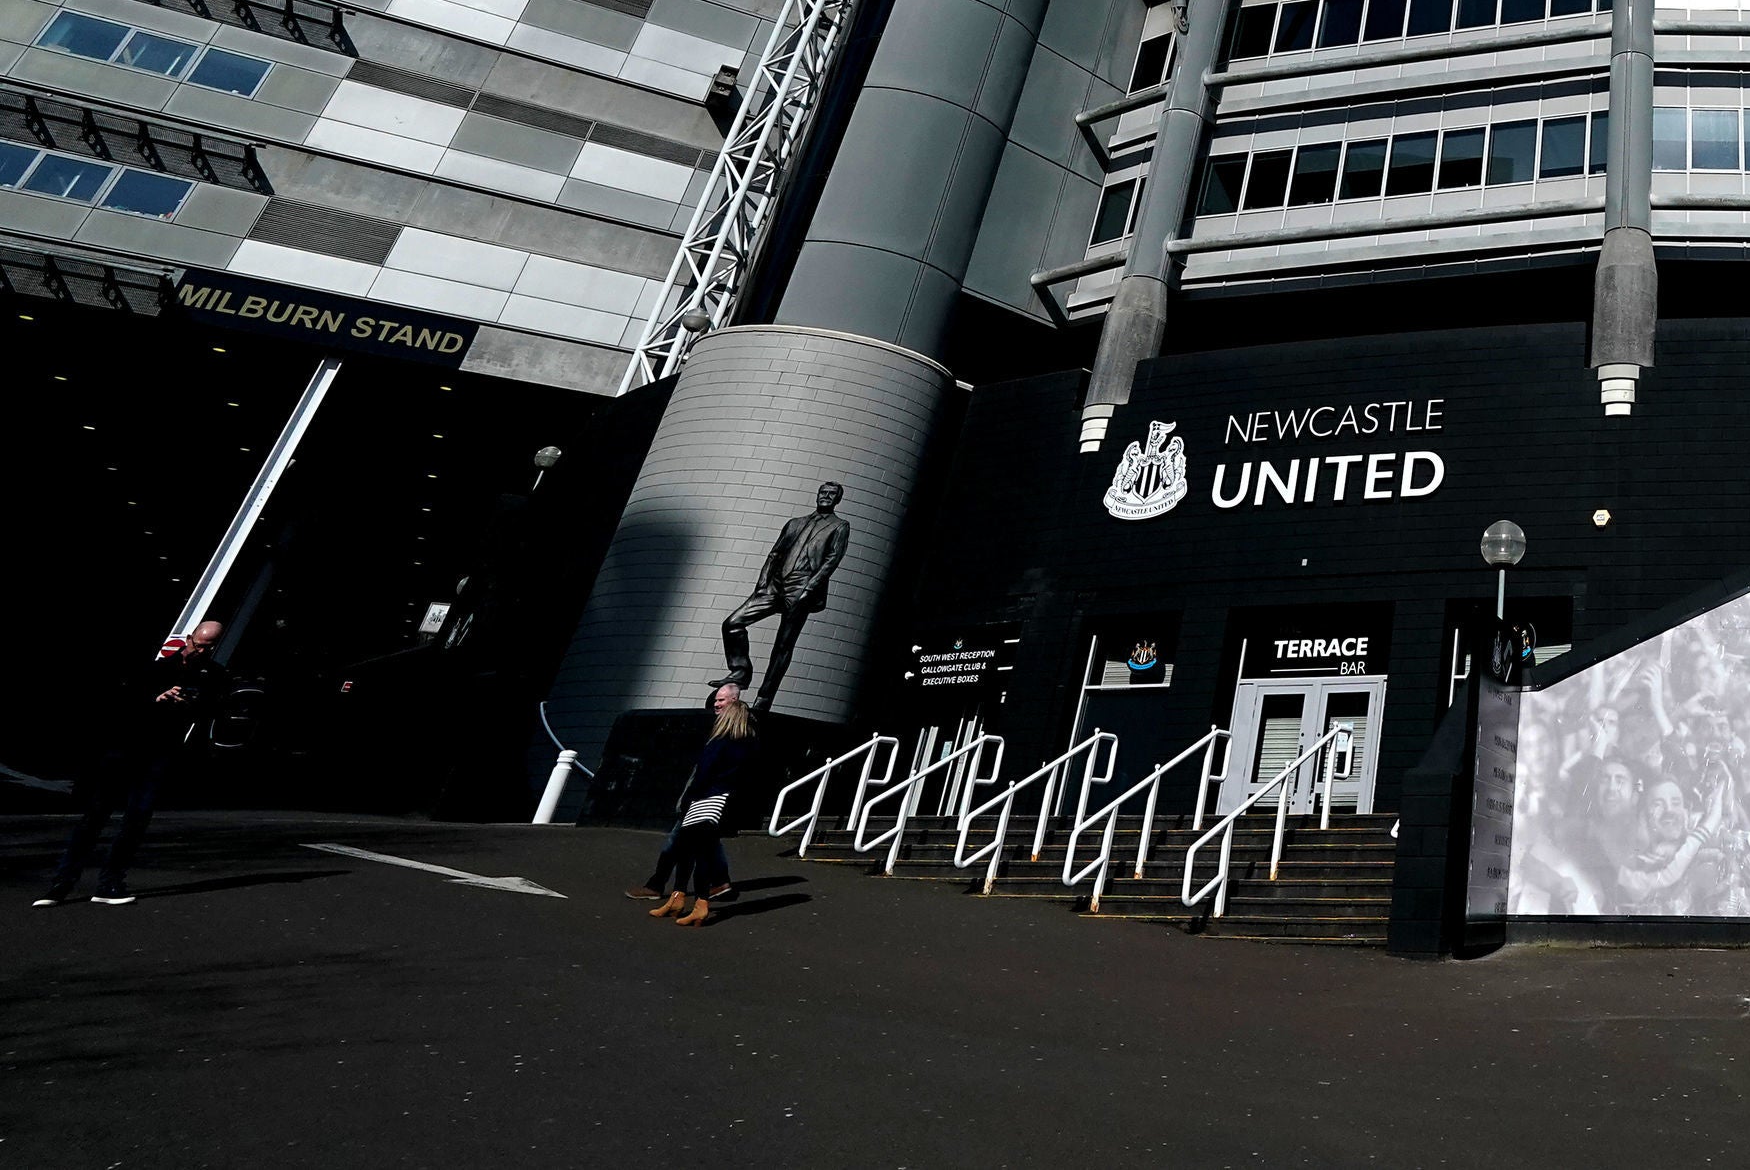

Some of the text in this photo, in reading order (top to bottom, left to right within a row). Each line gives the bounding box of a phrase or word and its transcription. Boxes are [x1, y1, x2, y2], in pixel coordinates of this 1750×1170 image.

[178, 283, 464, 354] MILBURN STAND
[1225, 398, 1445, 445] NEWCASTLE
[1211, 450, 1446, 509] UNITED
[1274, 637, 1369, 658] TERRACE
[920, 650, 995, 663] SOUTH WEST RECEPTION
[921, 662, 987, 674] GALLOWGATE CLUB &
[1340, 661, 1366, 675] BAR
[922, 674, 979, 685] EXECUTIVE BOXES
